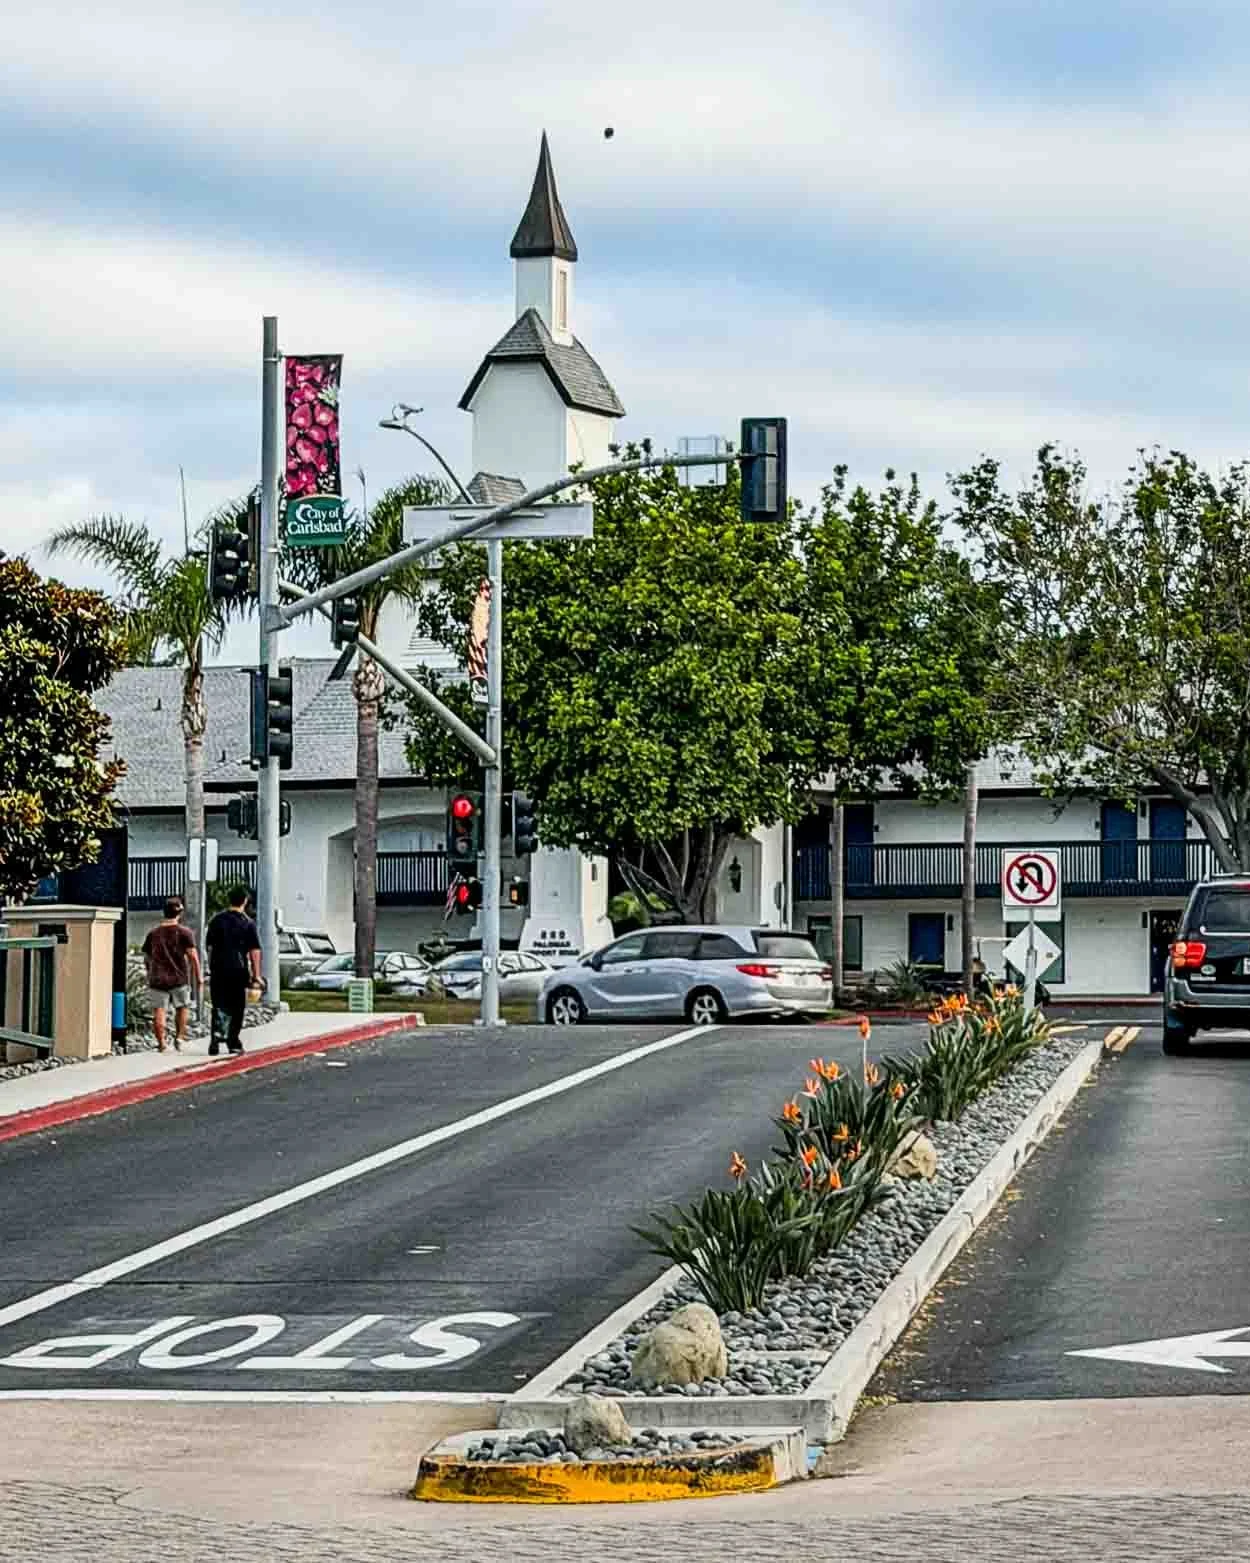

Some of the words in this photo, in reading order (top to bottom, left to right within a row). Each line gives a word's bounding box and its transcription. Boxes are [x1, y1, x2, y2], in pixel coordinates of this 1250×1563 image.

[329, 507, 340, 518] of
[287, 519, 343, 535] Carlsbad
[0, 1312, 520, 1369] STOP
